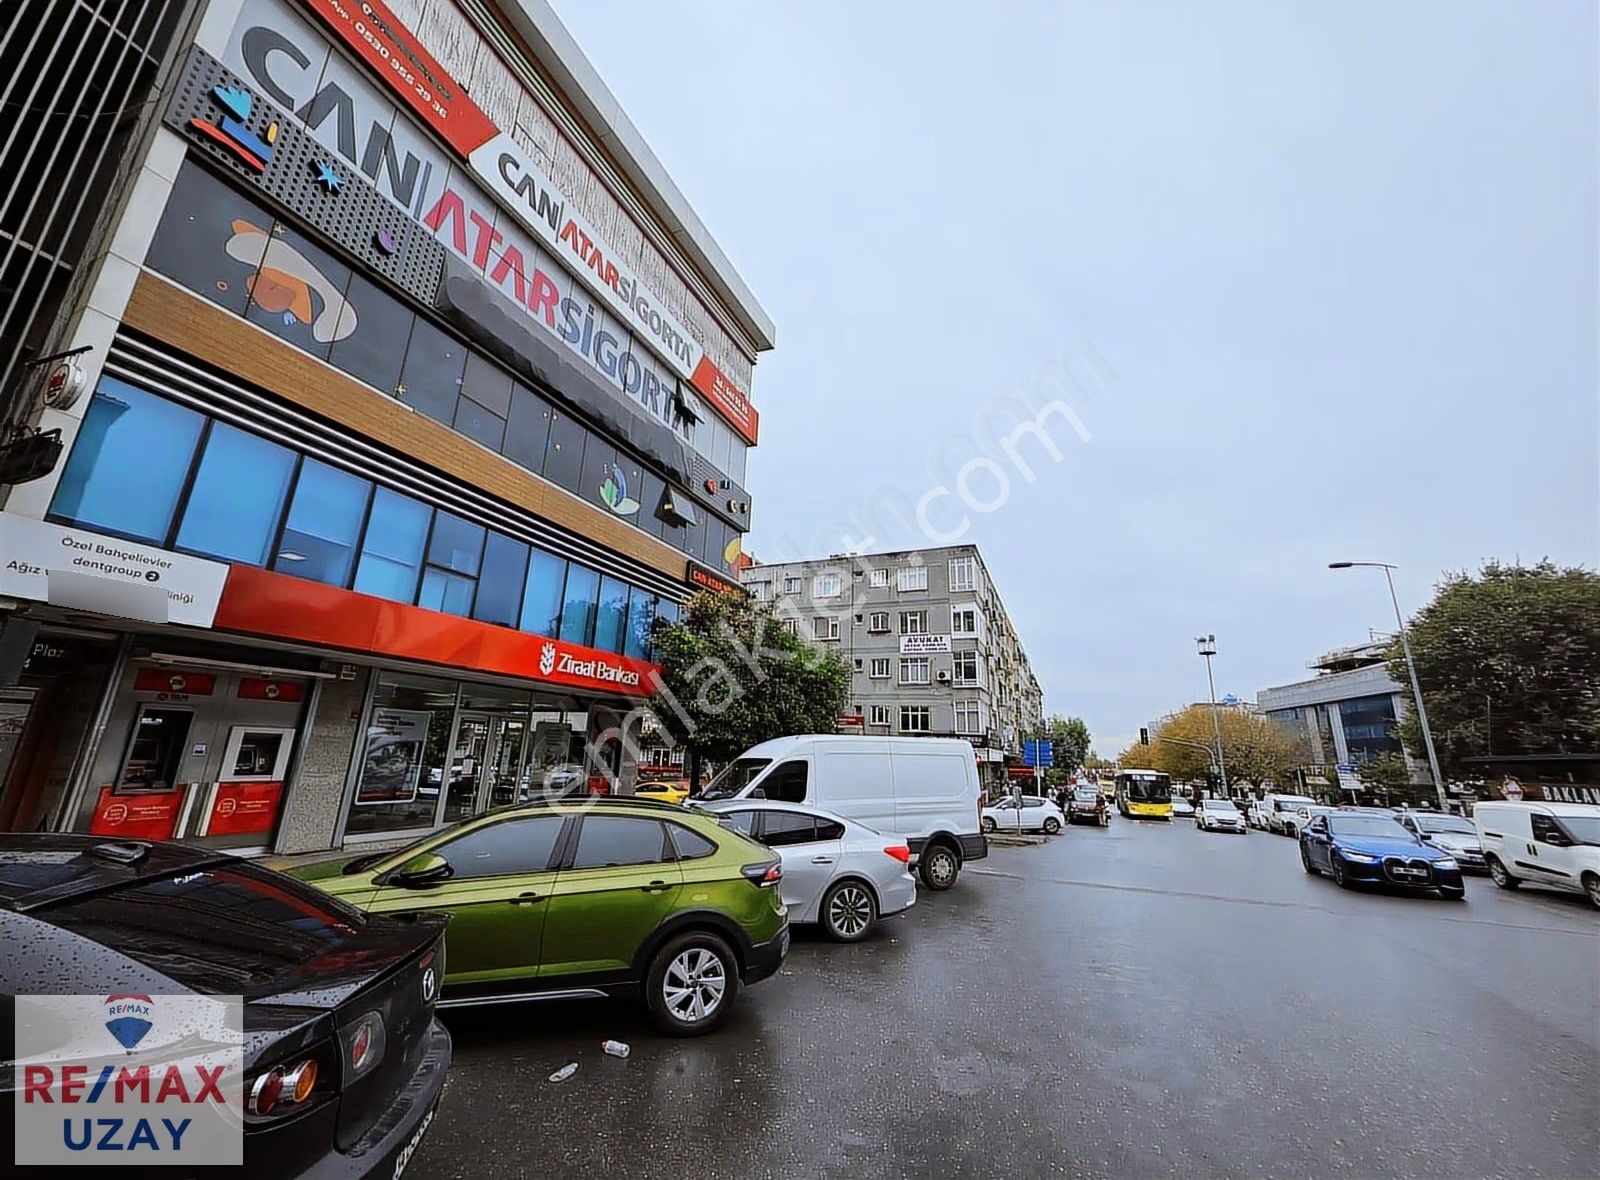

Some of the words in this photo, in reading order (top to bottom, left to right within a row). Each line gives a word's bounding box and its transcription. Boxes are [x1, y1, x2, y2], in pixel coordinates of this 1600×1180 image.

[241, 26, 420, 209] CAN
[498, 153, 559, 231] CAN
[62, 537, 93, 552] Özel
[95, 545, 173, 569] Bahçelievler
[73, 557, 142, 580] dentgroup
[6, 560, 41, 575] Ağız
[167, 591, 194, 604] liniği
[556, 652, 596, 679] Ziraat
[596, 661, 639, 686] Bankası
